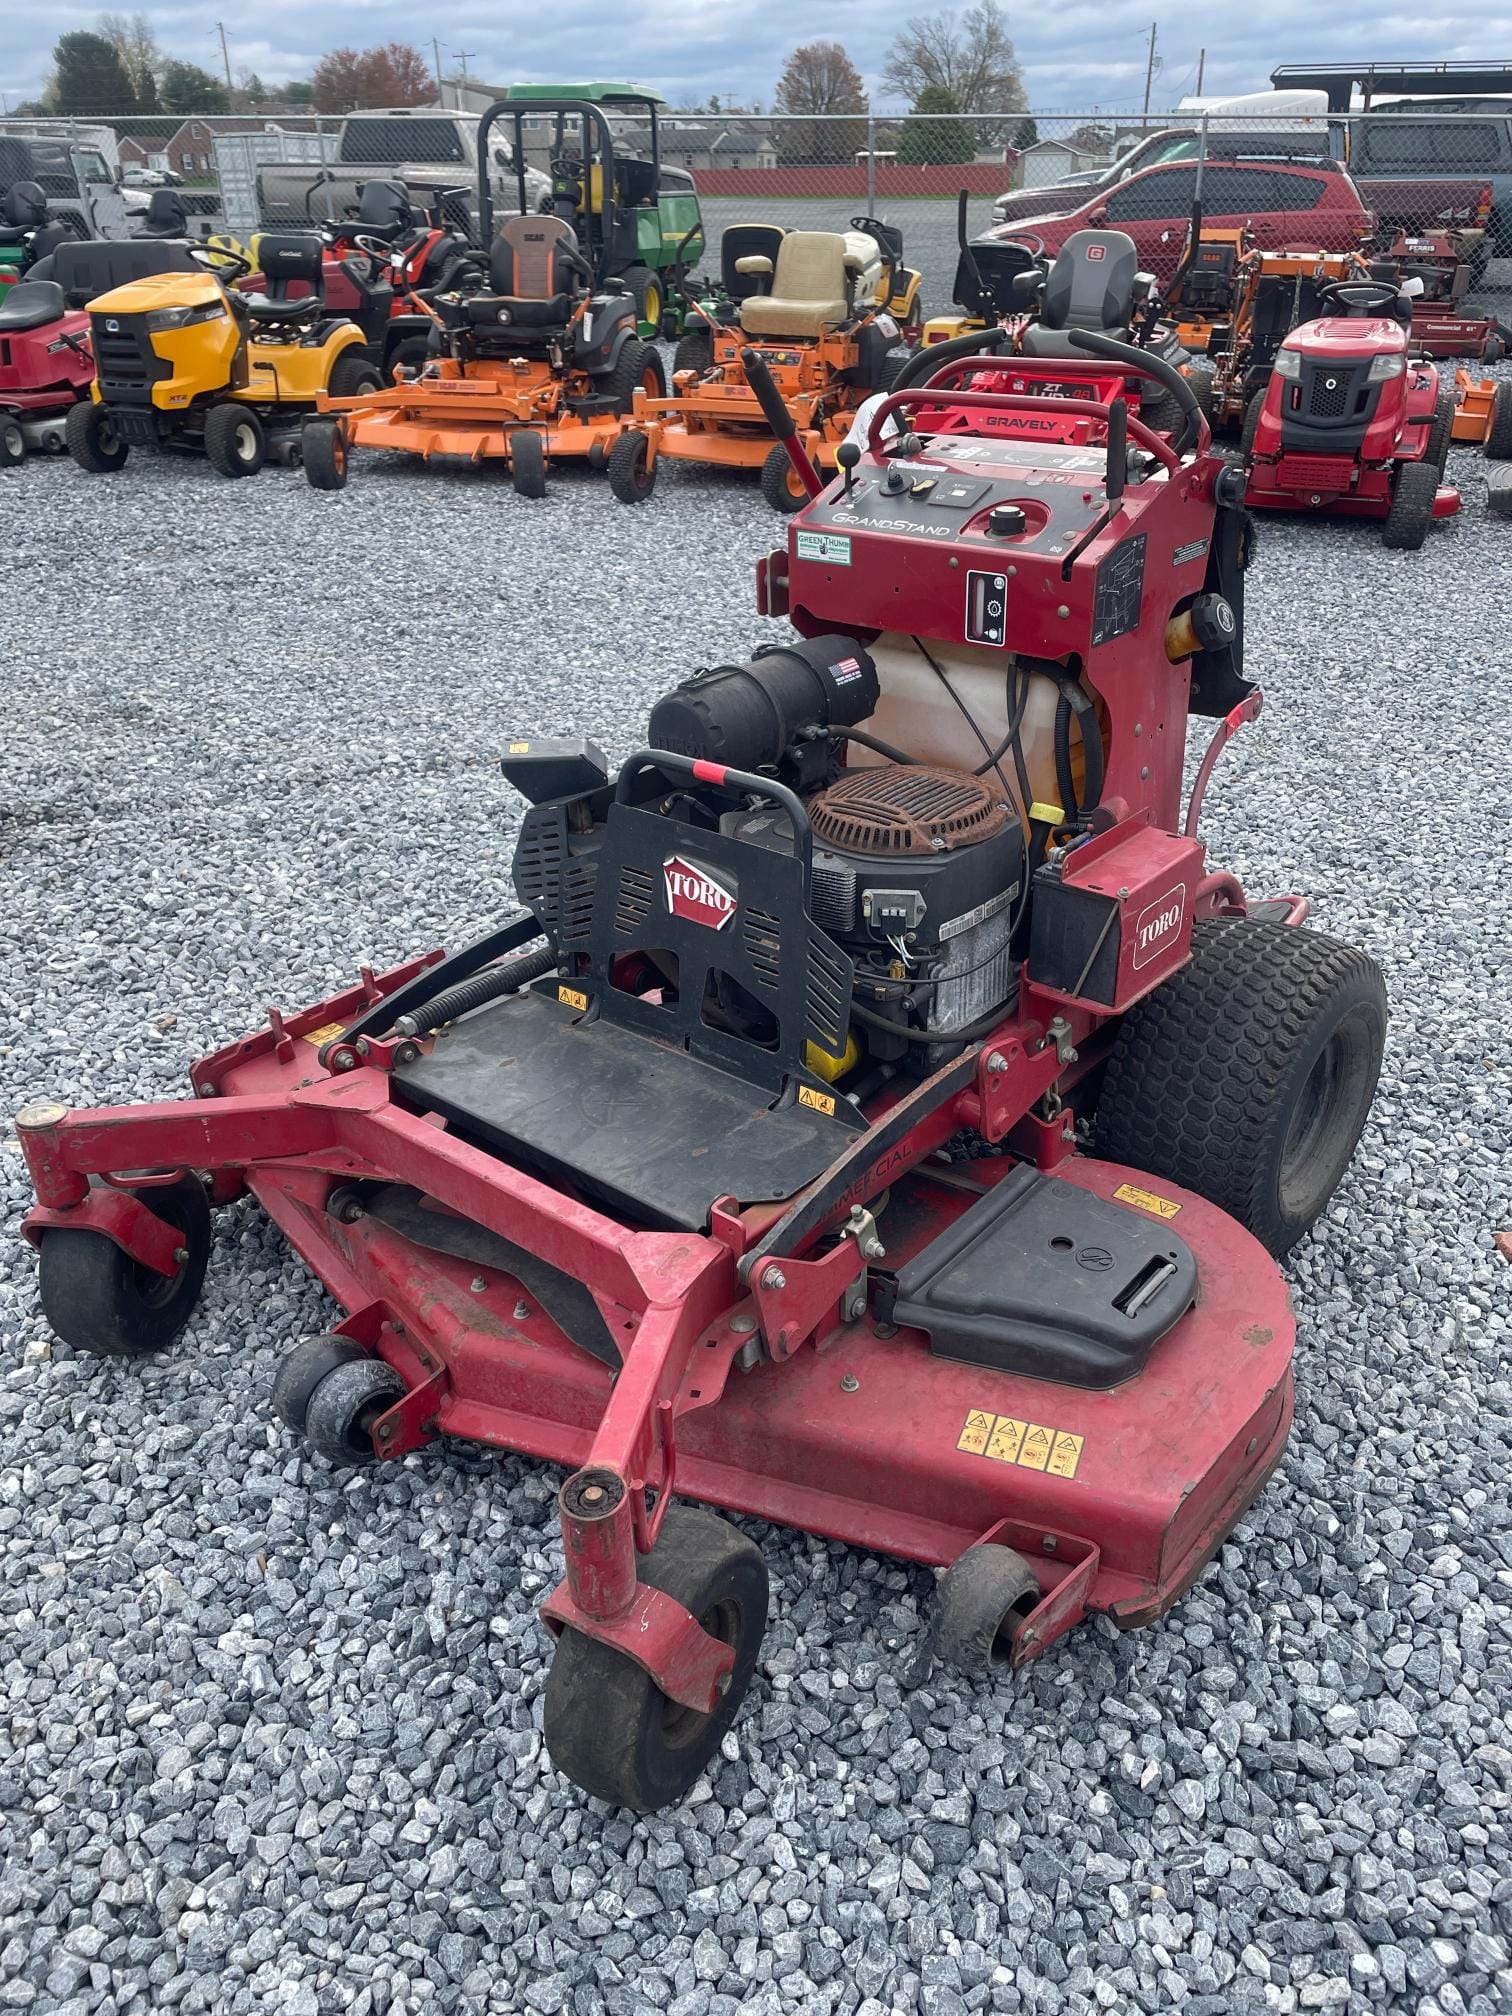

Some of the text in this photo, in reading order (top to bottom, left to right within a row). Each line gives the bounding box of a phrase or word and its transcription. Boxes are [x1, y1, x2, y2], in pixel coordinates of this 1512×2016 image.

[1408, 245, 1435, 253] FERRIS
[1041, 383, 1062, 392] ZT
[986, 415, 1058, 431] GRAVELY
[798, 535, 823, 545] GREEN
[823, 536, 850, 549] THUMB
[669, 870, 732, 912] TORO
[1140, 904, 1180, 950] TORO
